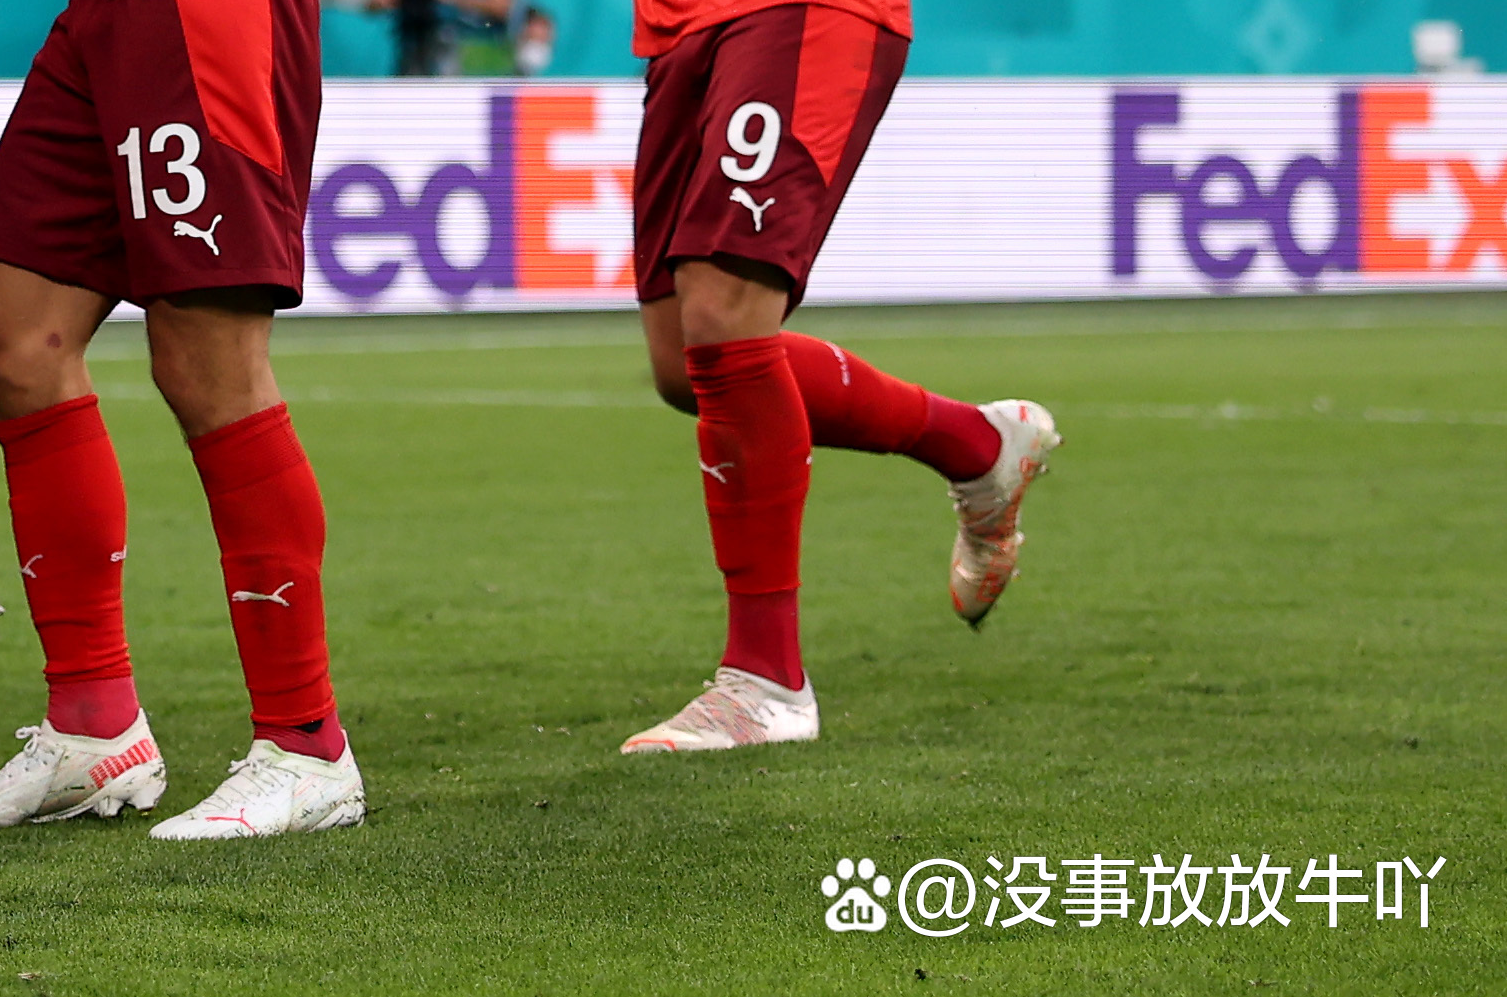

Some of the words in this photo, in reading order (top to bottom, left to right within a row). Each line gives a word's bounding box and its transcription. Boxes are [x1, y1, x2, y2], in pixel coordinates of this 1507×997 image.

[117, 123, 206, 219] 13
[309, 91, 636, 295] edE
[720, 101, 782, 182] 9
[1112, 87, 1507, 282] FedEx
